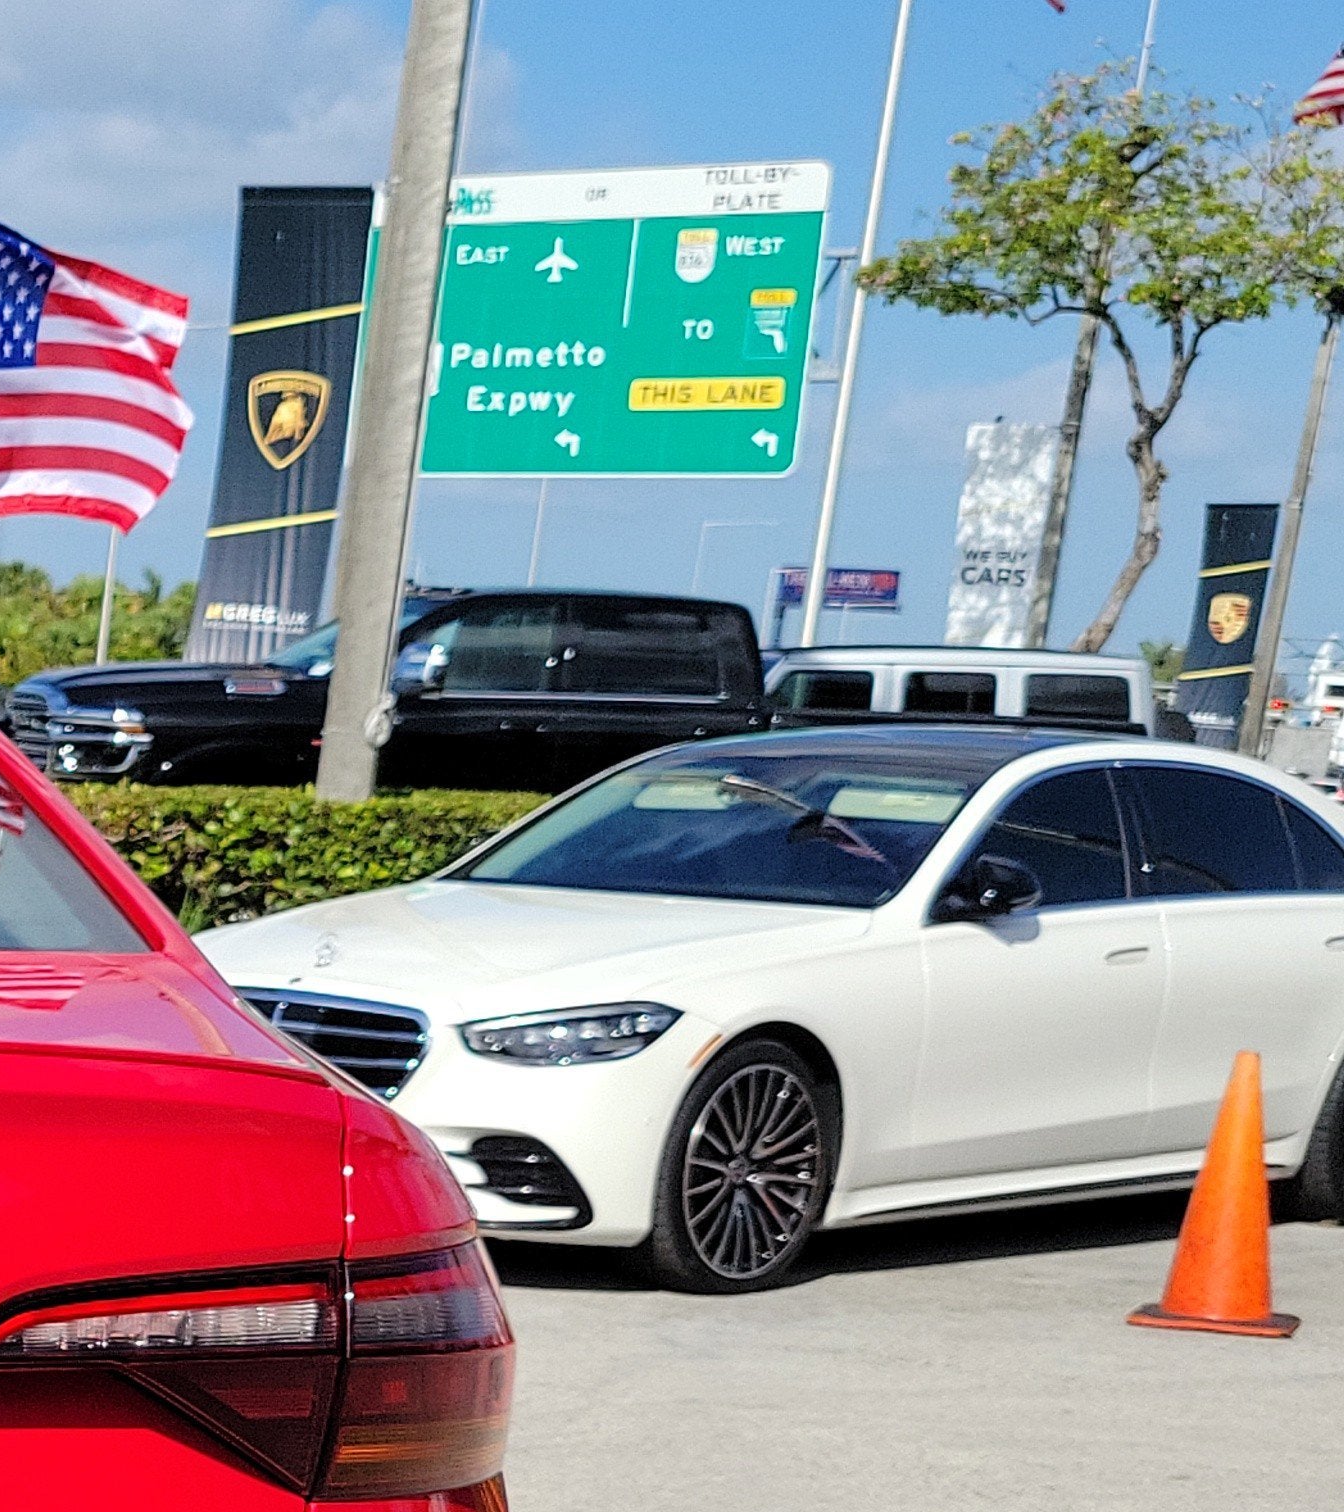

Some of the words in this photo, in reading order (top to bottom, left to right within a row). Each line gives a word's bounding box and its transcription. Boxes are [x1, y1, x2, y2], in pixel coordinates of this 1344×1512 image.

[713, 193, 783, 211] PLATE
[456, 244, 510, 265] EAST
[725, 235, 786, 256] WEST
[682, 319, 714, 340] TO
[450, 340, 606, 368] Palmetto
[467, 385, 576, 417] Expwy
[639, 383, 693, 404] THIS
[706, 383, 779, 403] LANE
[961, 567, 1026, 587] CARS
